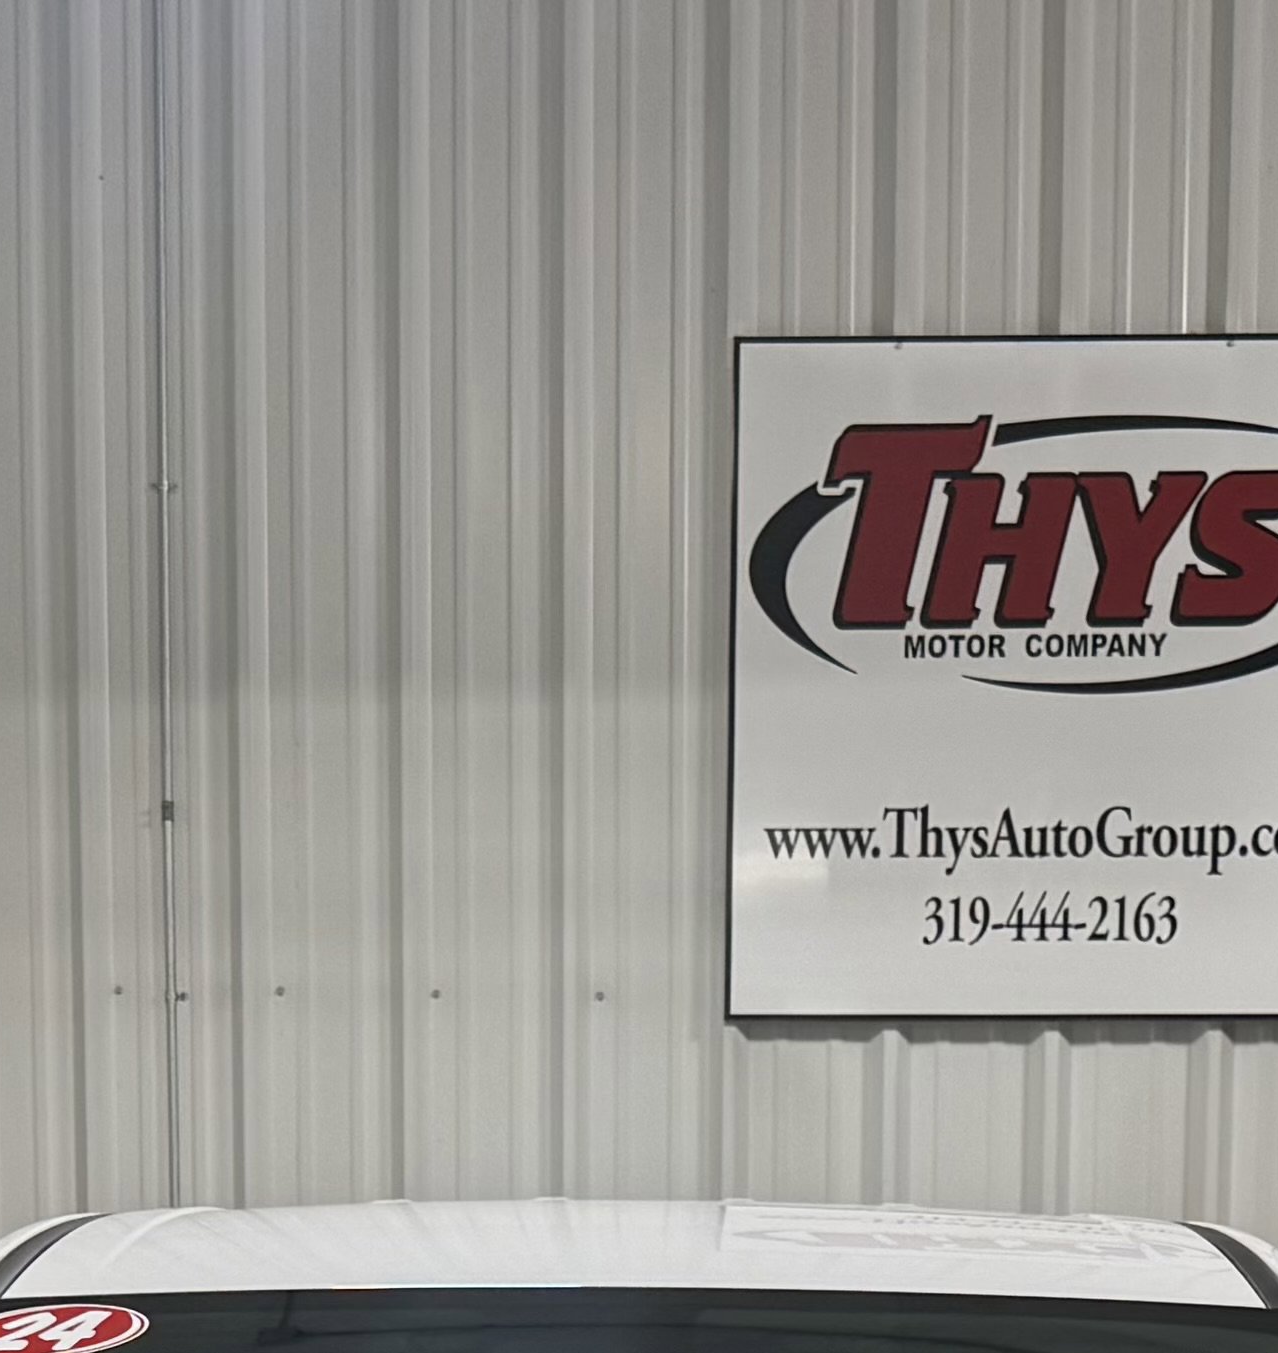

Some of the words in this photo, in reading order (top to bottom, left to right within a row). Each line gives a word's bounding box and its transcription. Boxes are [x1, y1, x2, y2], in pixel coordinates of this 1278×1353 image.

[903, 634, 1007, 660] MOTOR
[1025, 632, 1168, 659] COMPANY
[921, 891, 1179, 946] 319-444-2163
